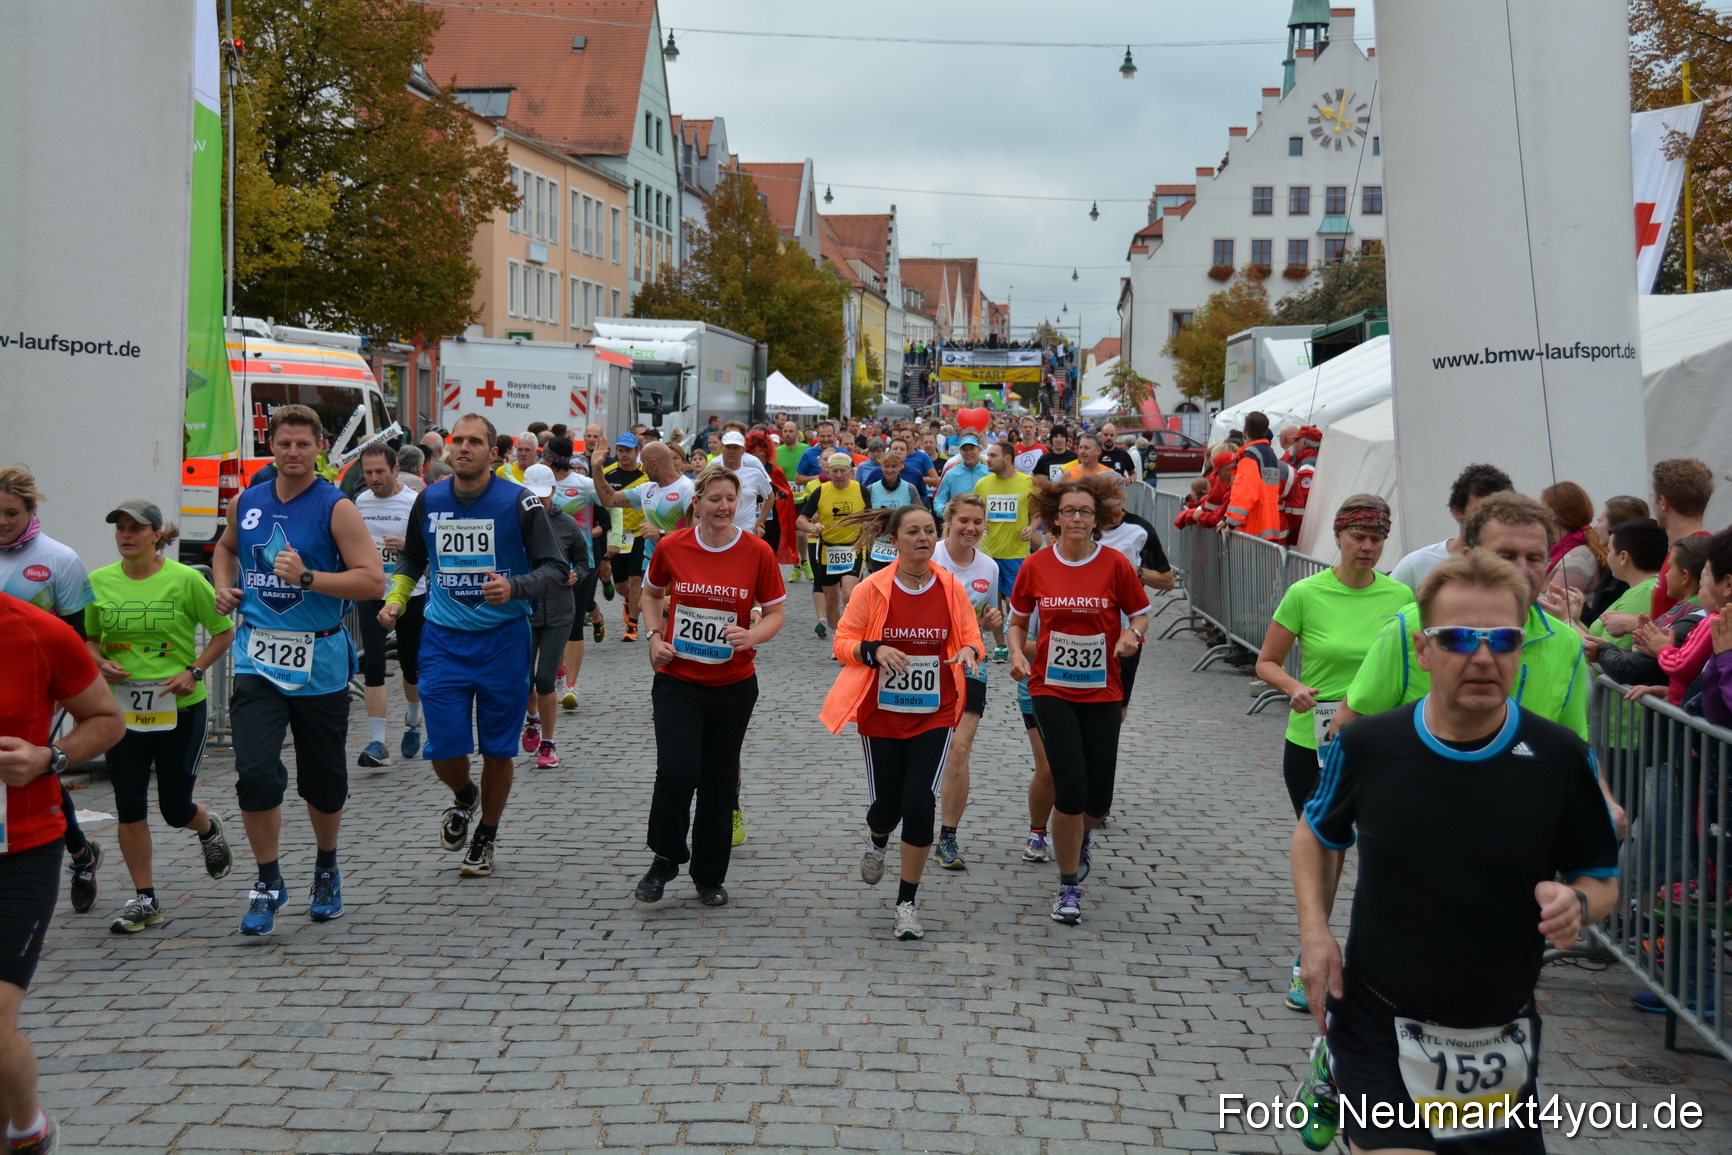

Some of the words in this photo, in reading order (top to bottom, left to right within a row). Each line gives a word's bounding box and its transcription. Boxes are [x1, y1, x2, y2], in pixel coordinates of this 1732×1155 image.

[1432, 342, 1636, 369] www.bmw-laufsport.de
[972, 371, 1006, 379] START
[507, 381, 557, 391] Bayerisches
[507, 391, 530, 400] Rotes
[506, 401, 530, 410] Kreuz
[769, 404, 802, 412] Laufsport
[990, 501, 1015, 511] 2110
[241, 508, 262, 530] 8
[457, 523, 484, 531] Neumarkt
[442, 532, 489, 552] 2019
[454, 557, 478, 566] Simon
[829, 553, 853, 564] 2693
[262, 590, 297, 599] BASKETS
[675, 581, 738, 598] NEUMARKT
[677, 608, 696, 619] PARTL
[696, 612, 726, 622] Neumarkt
[251, 630, 271, 640] PARTL
[271, 634, 303, 644] Neumarkt
[679, 618, 728, 645] 2604
[883, 627, 941, 639] EUMARKT
[1051, 635, 1070, 646] PARTL
[253, 640, 307, 668] 2128
[684, 643, 720, 658] Veronika
[1053, 646, 1103, 669] 2332
[263, 666, 292, 682] Roland
[884, 664, 936, 691] 2360
[1062, 672, 1091, 681] Kerstin
[131, 681, 162, 689] Neumark
[130, 691, 154, 710] 27
[894, 695, 924, 705] Sandra
[135, 715, 156, 724] Petra
[1400, 1030, 1442, 1046] PARTL
[1445, 1033, 1508, 1049] Neumarkt
[1429, 1050, 1507, 1094] 153
